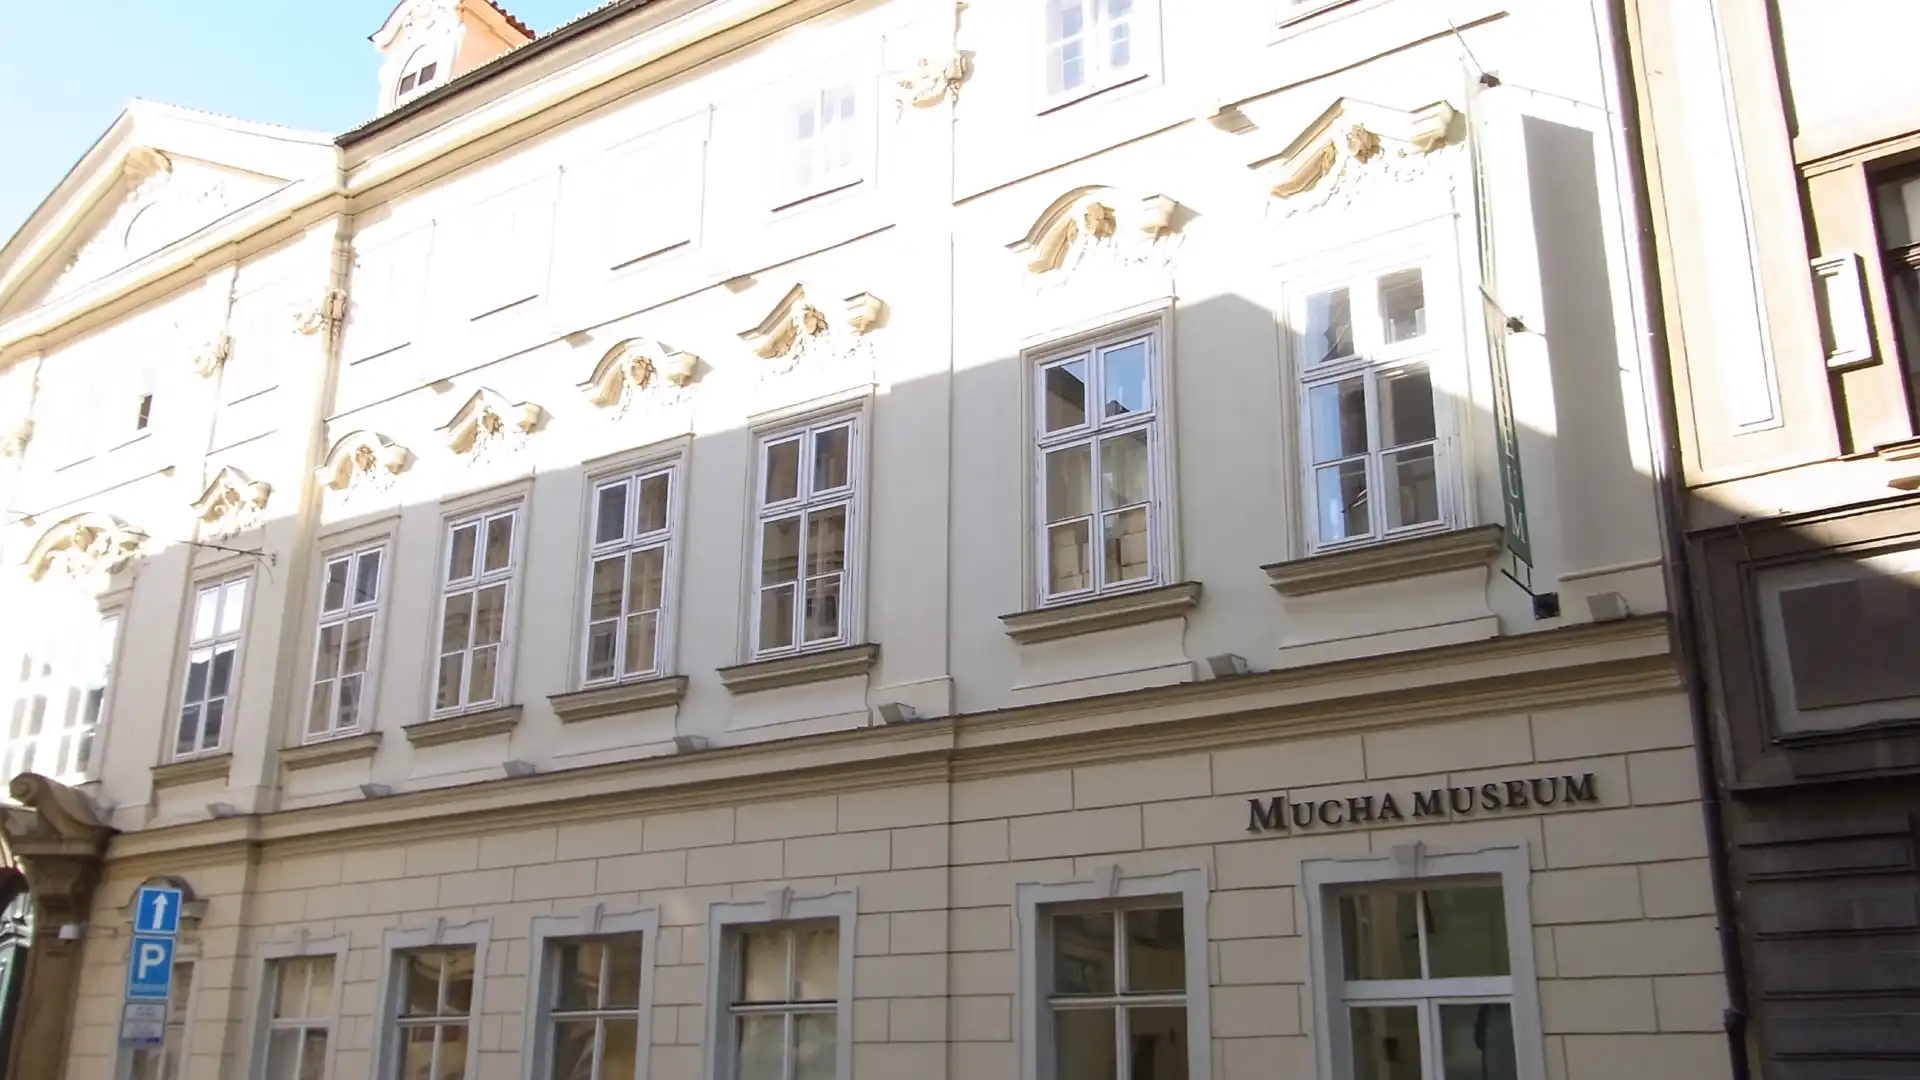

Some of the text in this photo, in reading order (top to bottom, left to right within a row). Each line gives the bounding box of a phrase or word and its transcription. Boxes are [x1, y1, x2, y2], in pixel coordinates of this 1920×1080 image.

[1246, 773, 1600, 832] MUCHA MUSEUM
[138, 943, 165, 980] P
